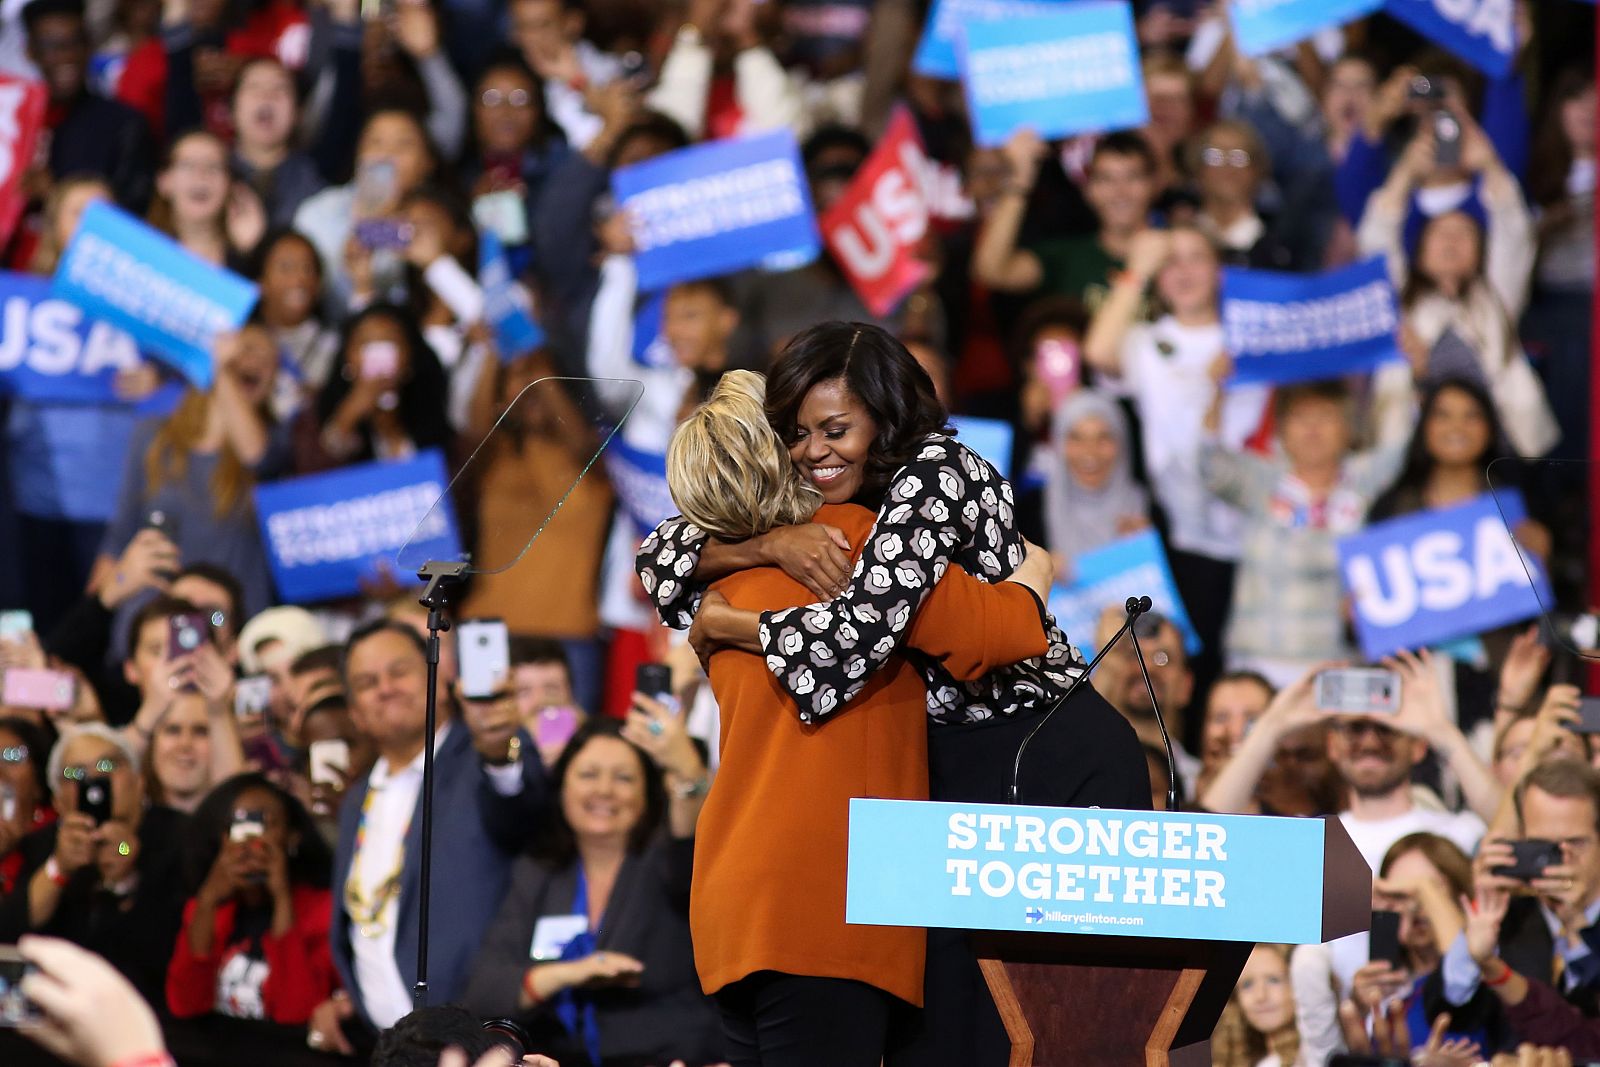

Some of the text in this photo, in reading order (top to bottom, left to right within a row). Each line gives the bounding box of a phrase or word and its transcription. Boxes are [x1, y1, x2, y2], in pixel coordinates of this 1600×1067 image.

[1347, 516, 1539, 627] USA
[947, 812, 1228, 861] STRONGER
[946, 858, 1226, 908] TOGETHER
[1045, 911, 1144, 926] hillaryclinton.com
